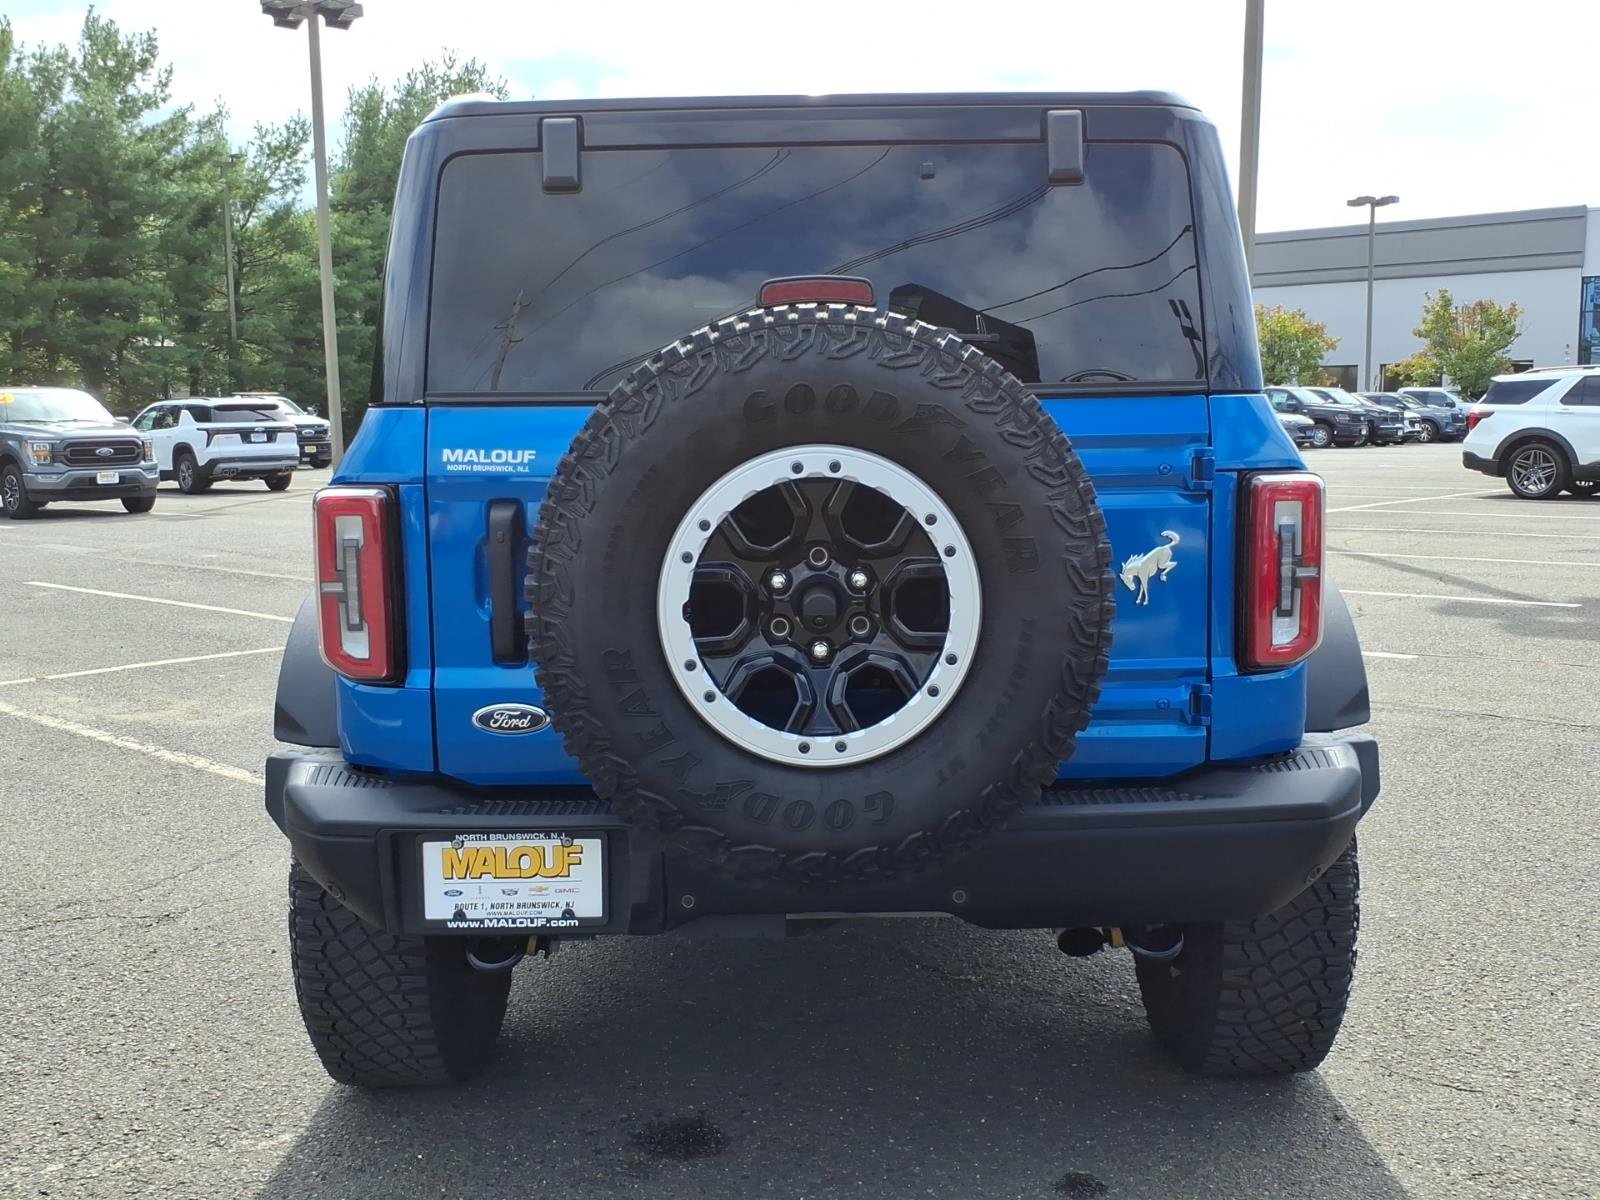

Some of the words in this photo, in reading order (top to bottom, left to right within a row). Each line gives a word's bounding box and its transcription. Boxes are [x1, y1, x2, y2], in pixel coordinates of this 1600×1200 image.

[442, 448, 537, 463] MALOUF
[447, 464, 471, 472] NORTH
[490, 710, 531, 728] Ford
[442, 845, 584, 880] MALOUF
[455, 903, 478, 911] ROUTE
[490, 902, 514, 910] NORTH
[516, 901, 563, 910] BRUNSWICK,
[565, 901, 575, 909] NJ
[447, 918, 579, 929] www.MALOUF.com
